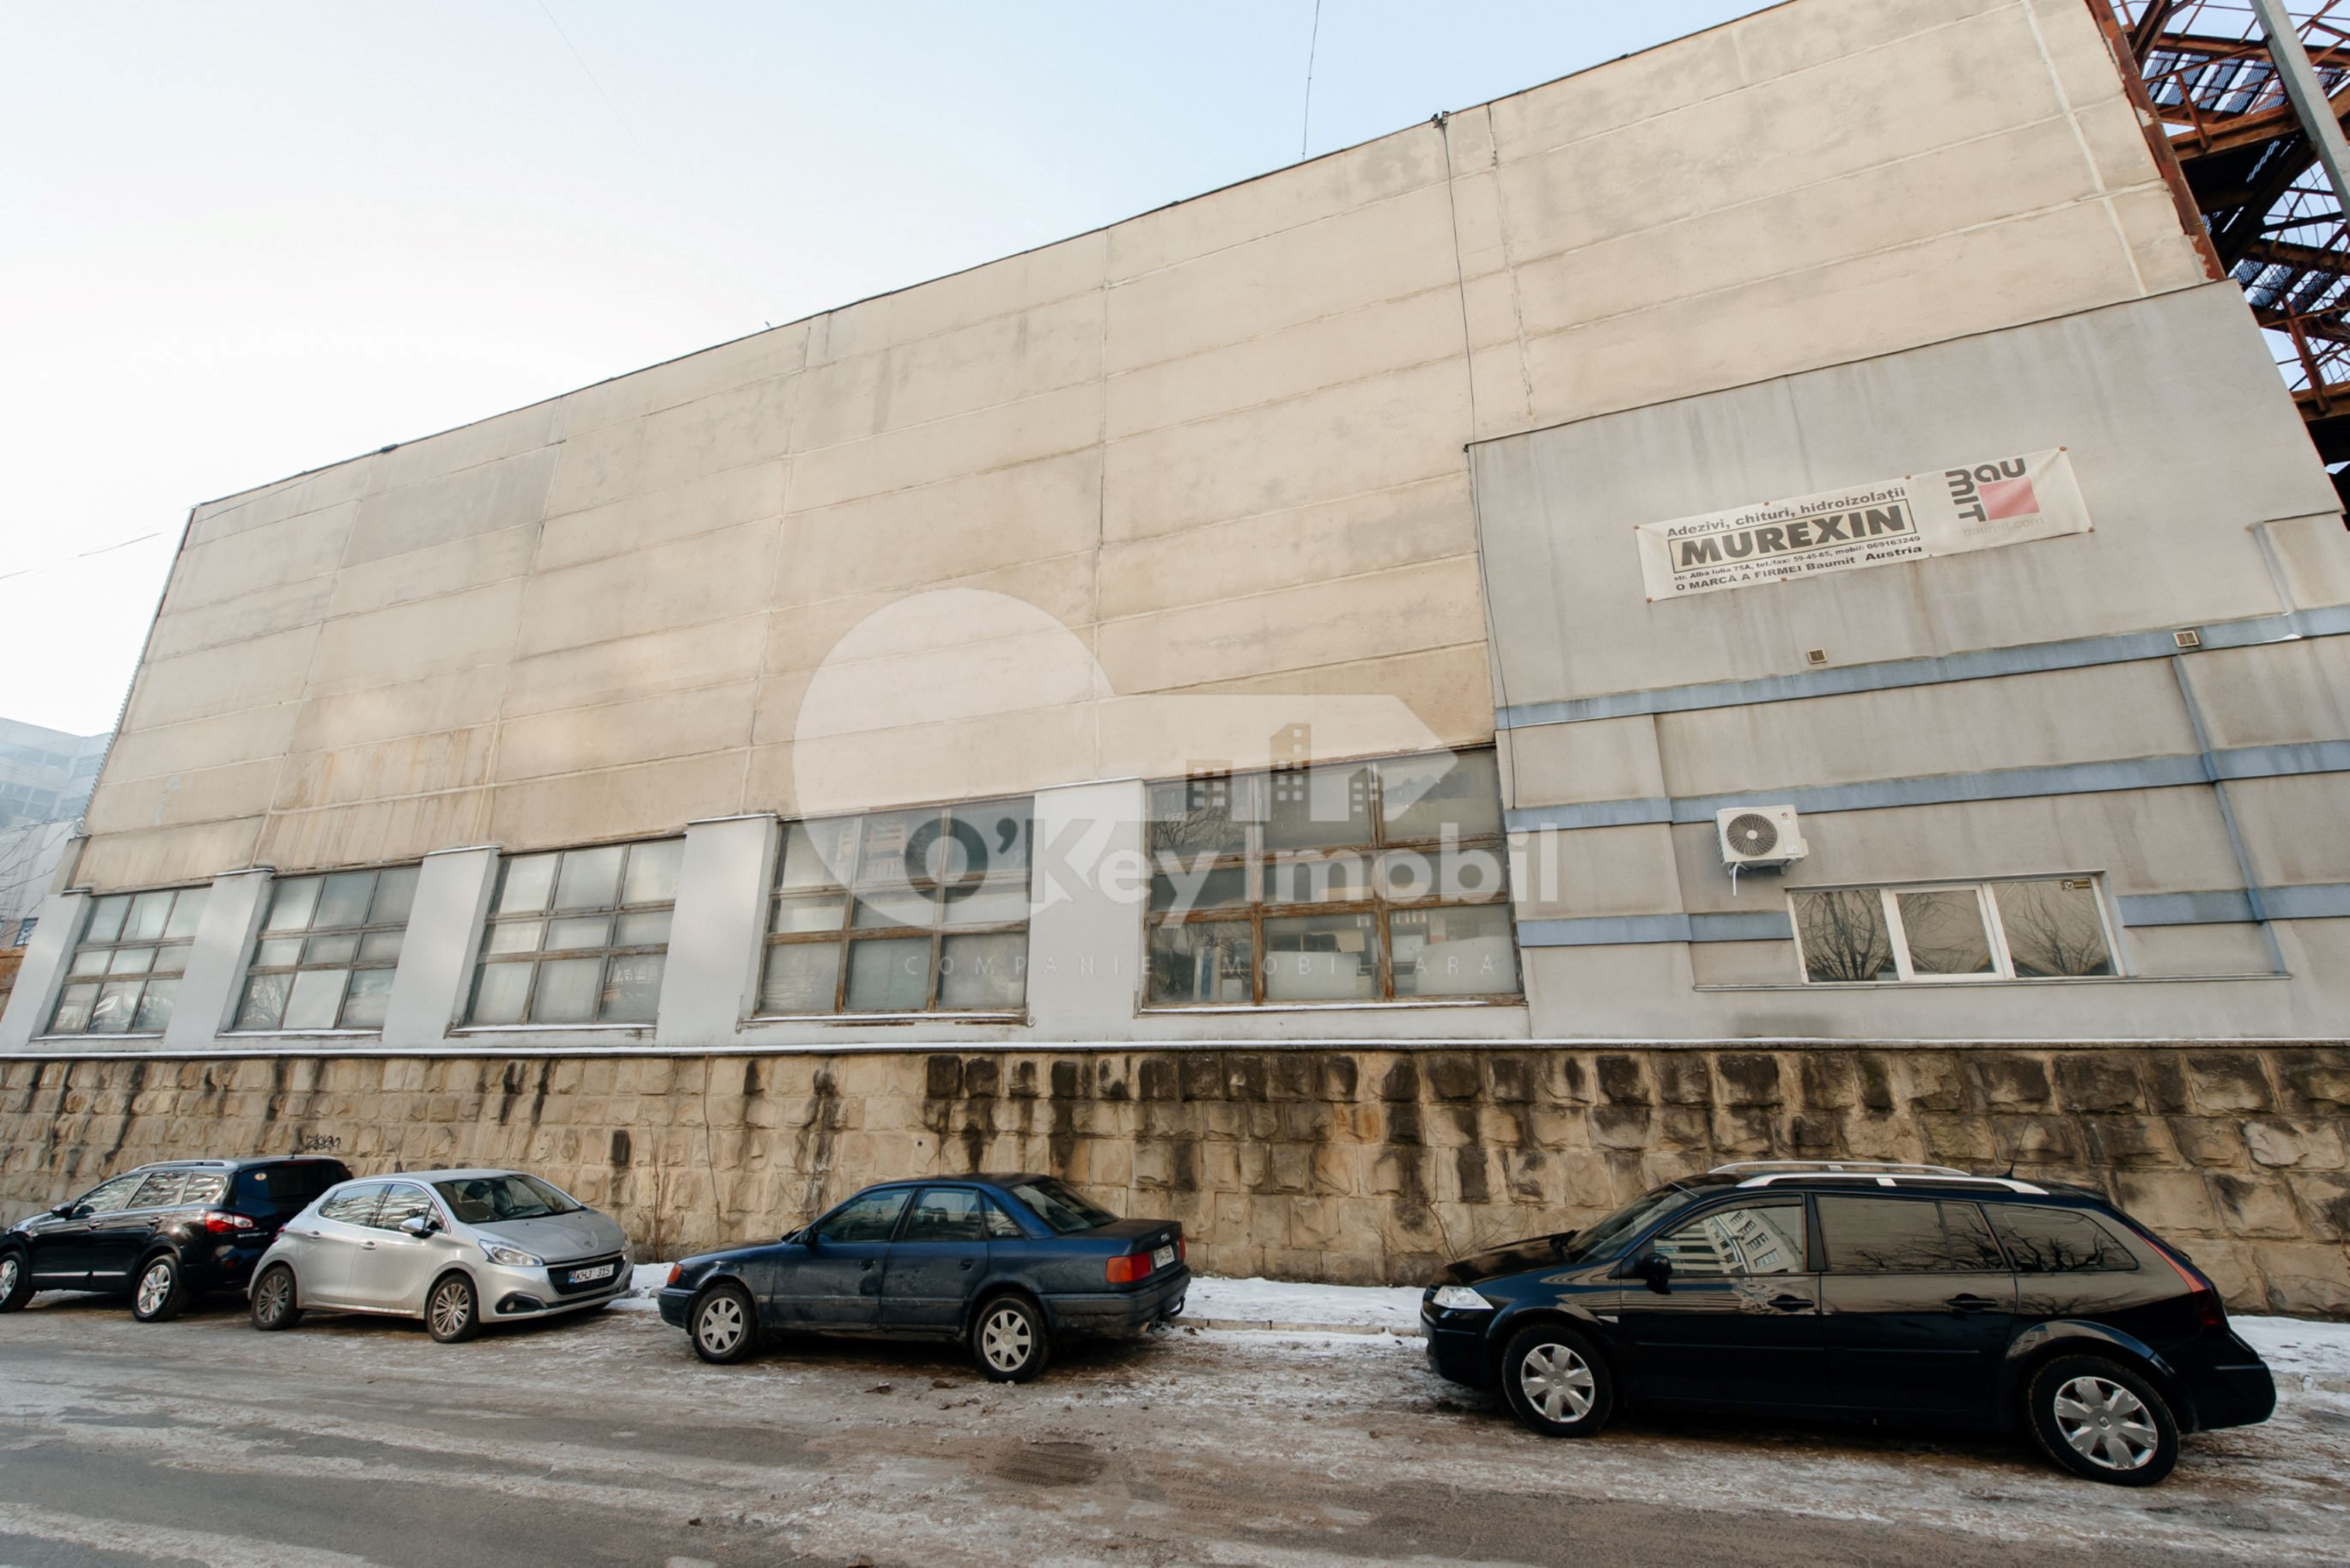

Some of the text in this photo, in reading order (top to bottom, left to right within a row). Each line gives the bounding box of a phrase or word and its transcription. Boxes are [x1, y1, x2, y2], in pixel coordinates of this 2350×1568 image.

[1667, 519, 1730, 538] Adezivi,
[1735, 507, 1795, 526] chituri,
[1682, 505, 1905, 567] MUREXIN
[1689, 570, 1710, 579] Alba
[1741, 573, 1751, 581] A
[1755, 565, 1802, 579] FIRMEI
[1806, 556, 1856, 571] Baumit
[1865, 546, 1923, 562] Austria
